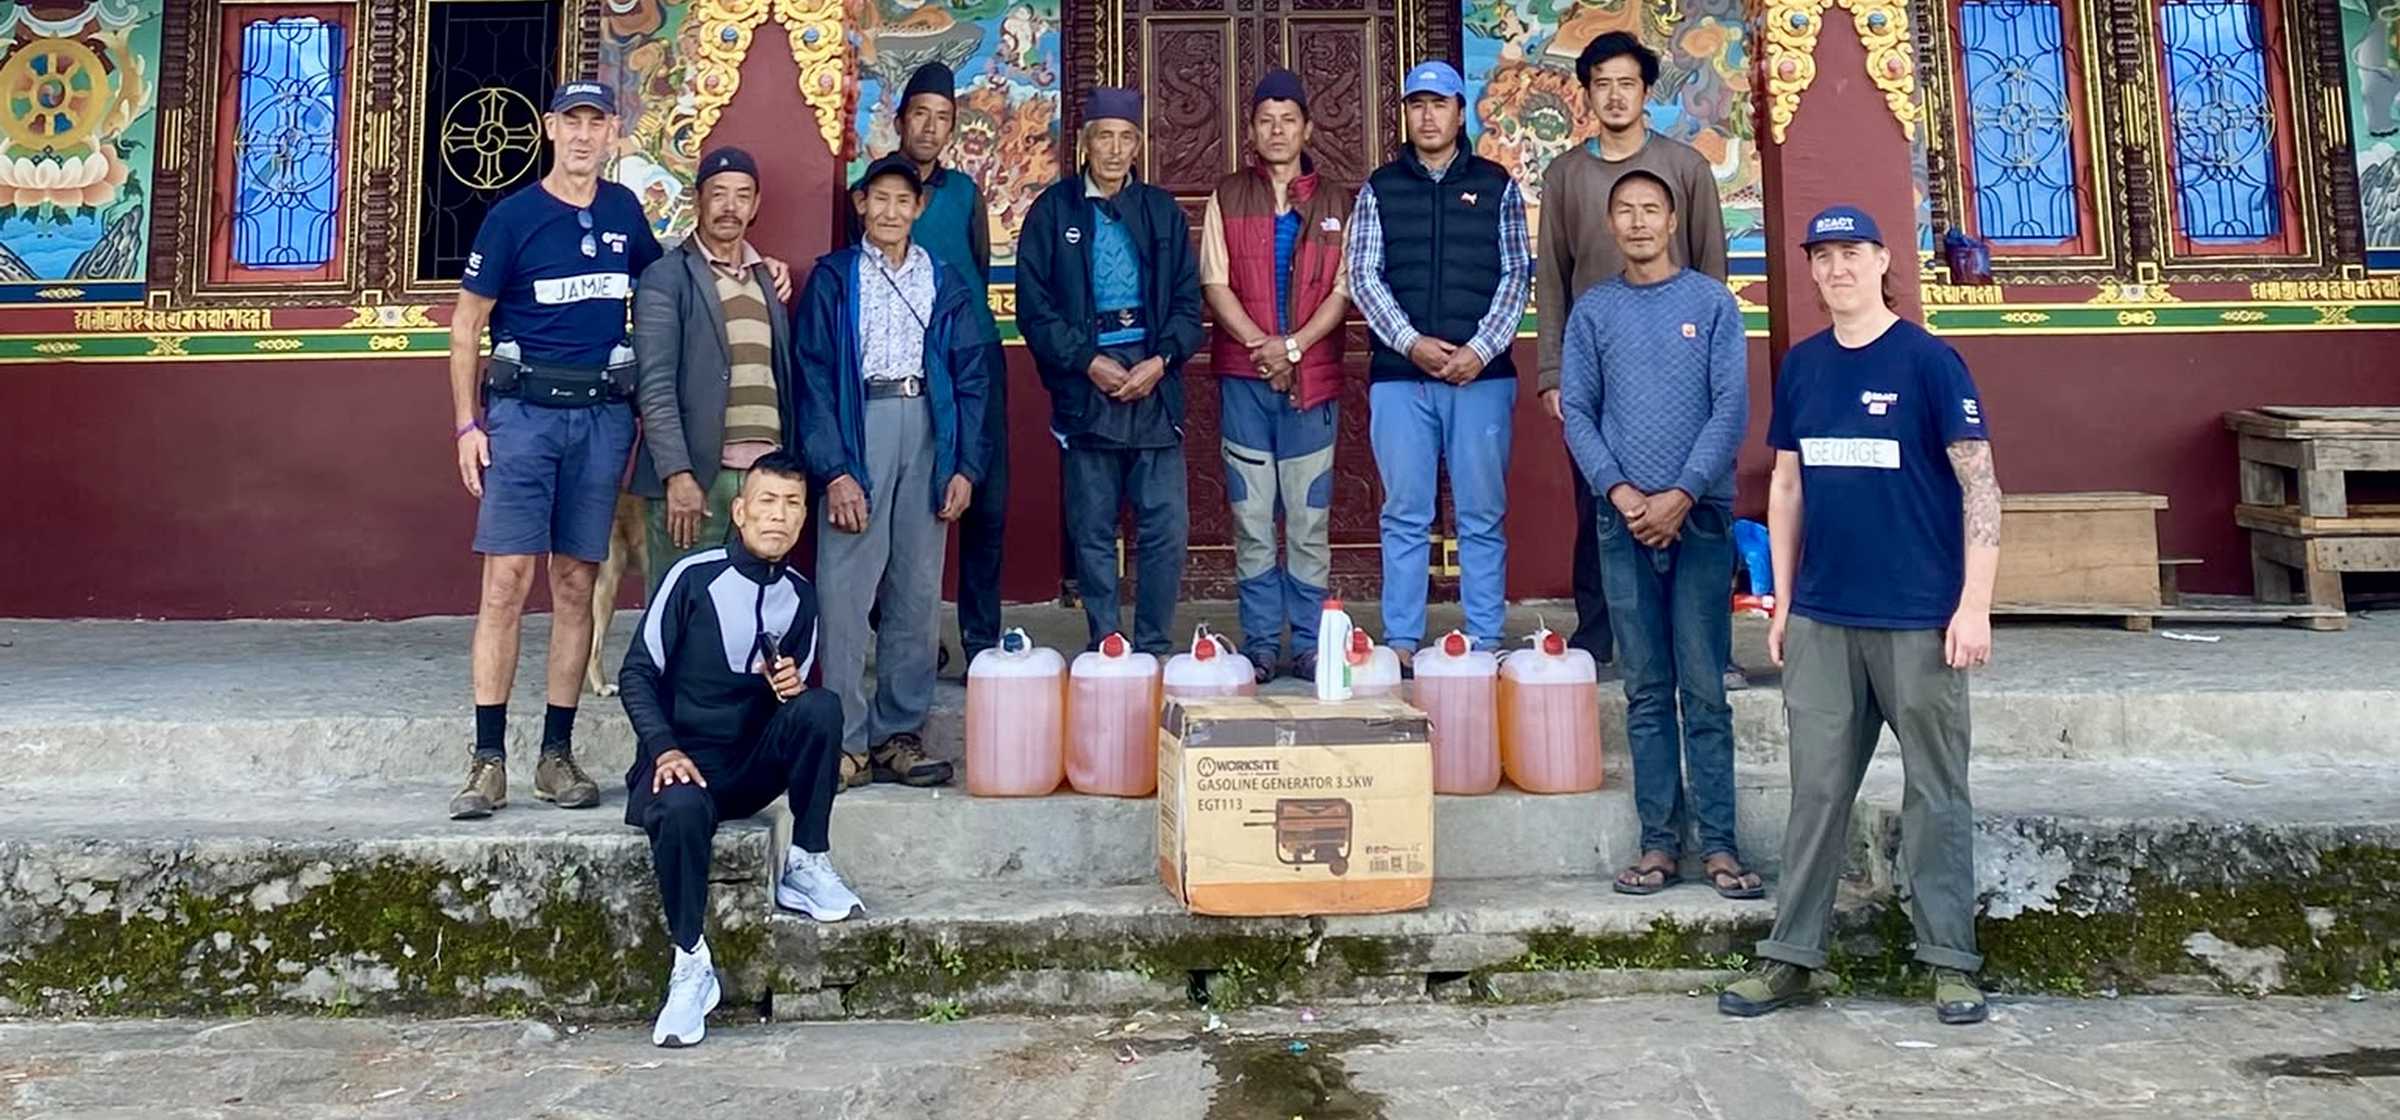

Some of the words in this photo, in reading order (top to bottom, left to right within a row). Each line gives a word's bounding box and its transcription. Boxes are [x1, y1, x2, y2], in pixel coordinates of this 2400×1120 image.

[556, 276, 612, 301] JAMIE
[1809, 441, 1885, 464] GEORGE
[1198, 777, 1259, 791] GASOLINE
[1261, 776, 1333, 790] GENERATOR
[1336, 776, 1374, 788] 3.5KW
[1198, 799, 1243, 811] EGT113
